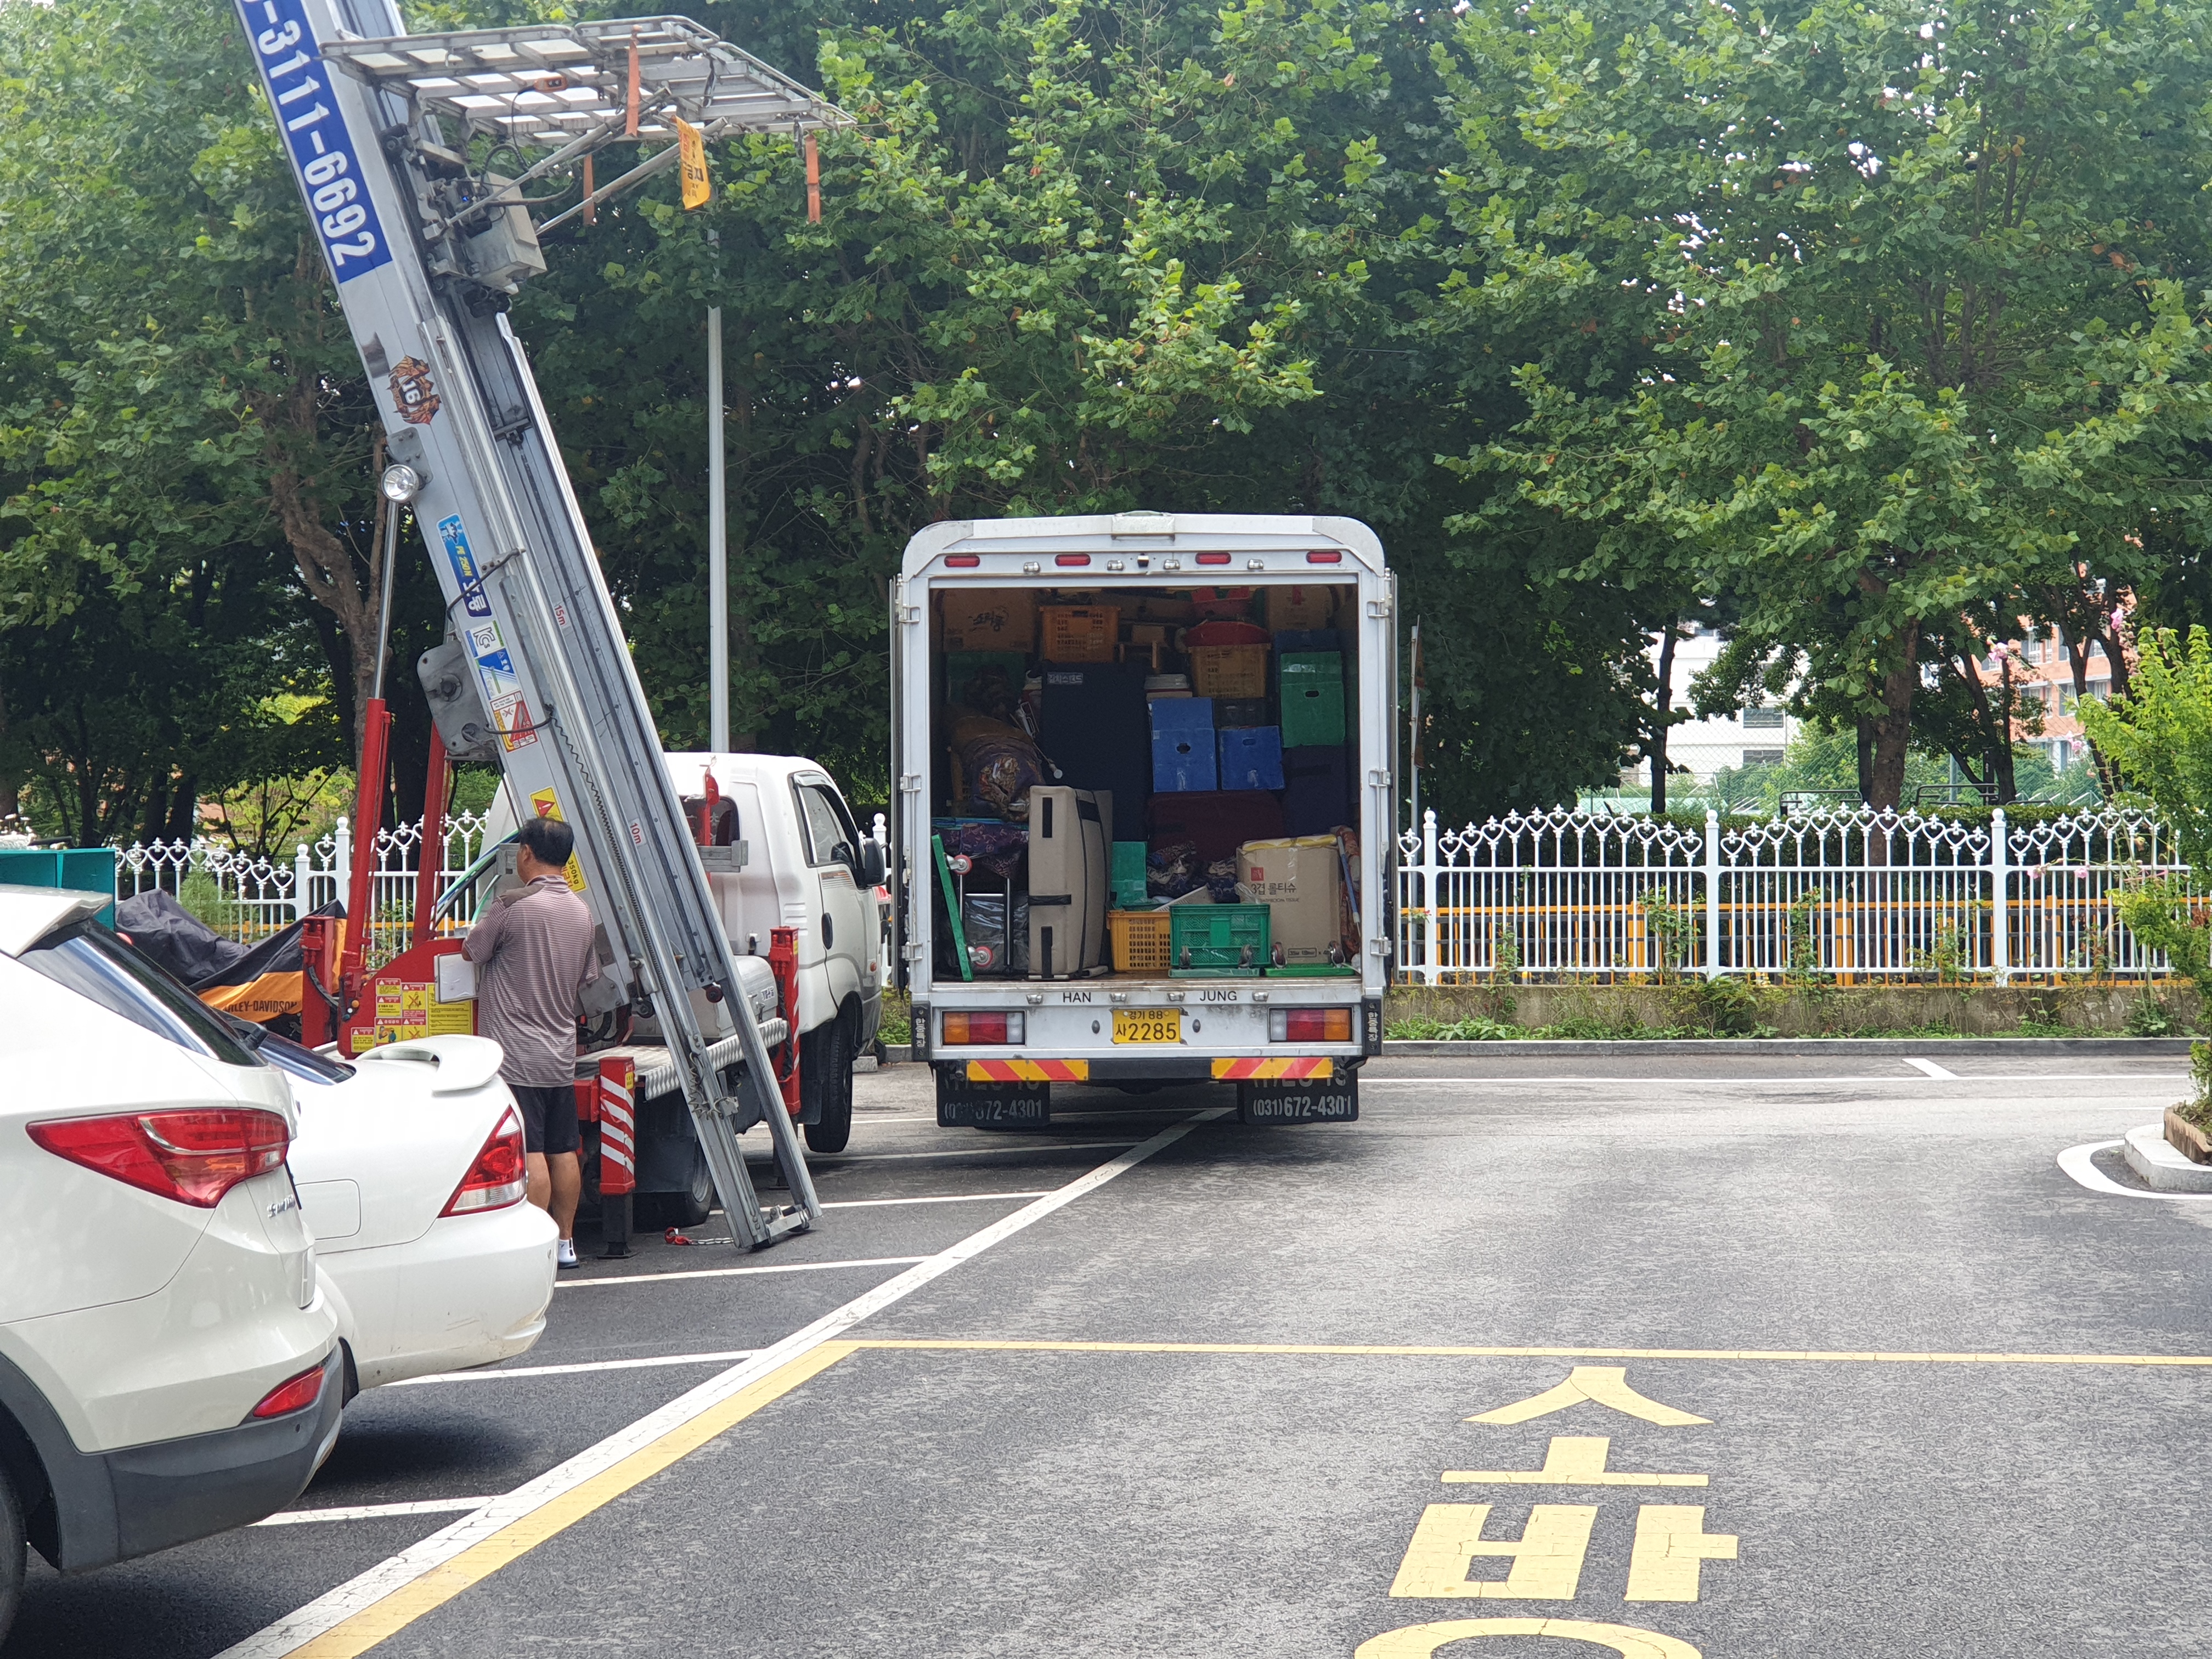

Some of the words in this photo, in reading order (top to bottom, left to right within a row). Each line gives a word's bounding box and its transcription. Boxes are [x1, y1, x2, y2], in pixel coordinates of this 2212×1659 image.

[242, 0, 376, 267] -3111-6692
[400, 380, 422, 404] 16
[555, 605, 566, 625] 15m
[630, 823, 641, 844] 10m
[1268, 882, 1297, 895] 롤티슈
[1063, 992, 1092, 1003] HAN
[1199, 991, 1238, 1002] JUNG
[1129, 1011, 1145, 1020] 경기
[1148, 1010, 1163, 1019] 88
